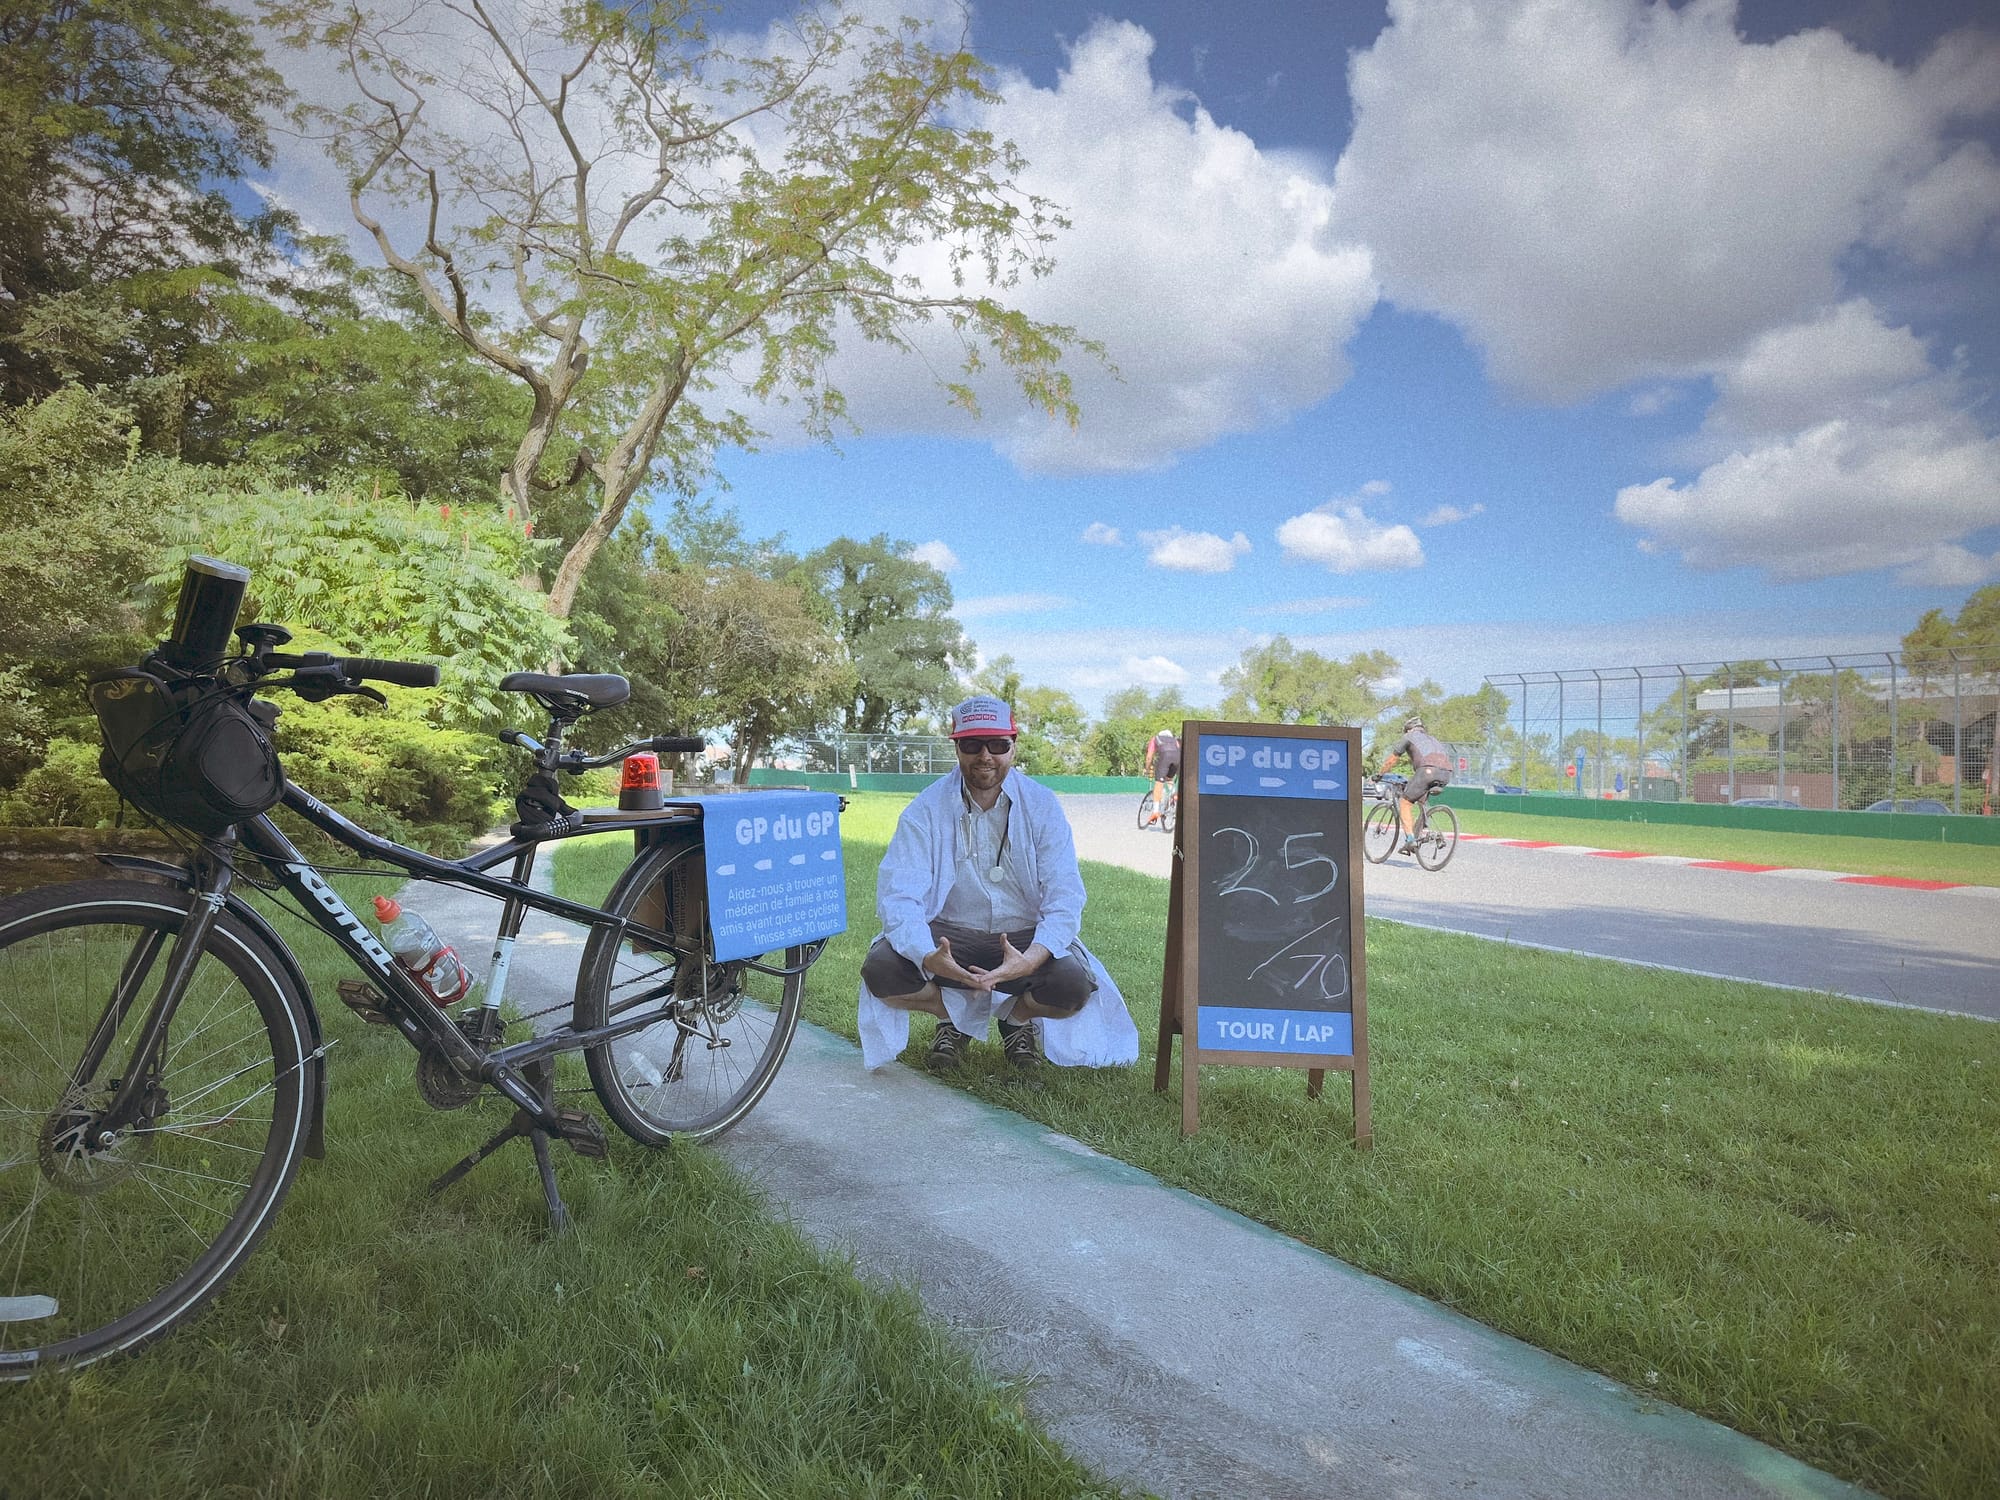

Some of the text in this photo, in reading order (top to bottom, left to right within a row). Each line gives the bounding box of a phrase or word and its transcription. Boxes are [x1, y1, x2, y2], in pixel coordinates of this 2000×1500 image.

[1205, 744, 1340, 772] GP du GP
[735, 811, 834, 846] GP du GP
[1212, 827, 1339, 906] 25
[728, 874, 838, 902] Aidez-nous à trouver un
[725, 888, 839, 919] médecin de famille à nos
[719, 902, 840, 937] amis avant que ce cycliste
[753, 918, 841, 945] finisse ses 70 tours.
[1216, 1021, 1275, 1041] TOUR
[1295, 1024, 1335, 1043] LAP
